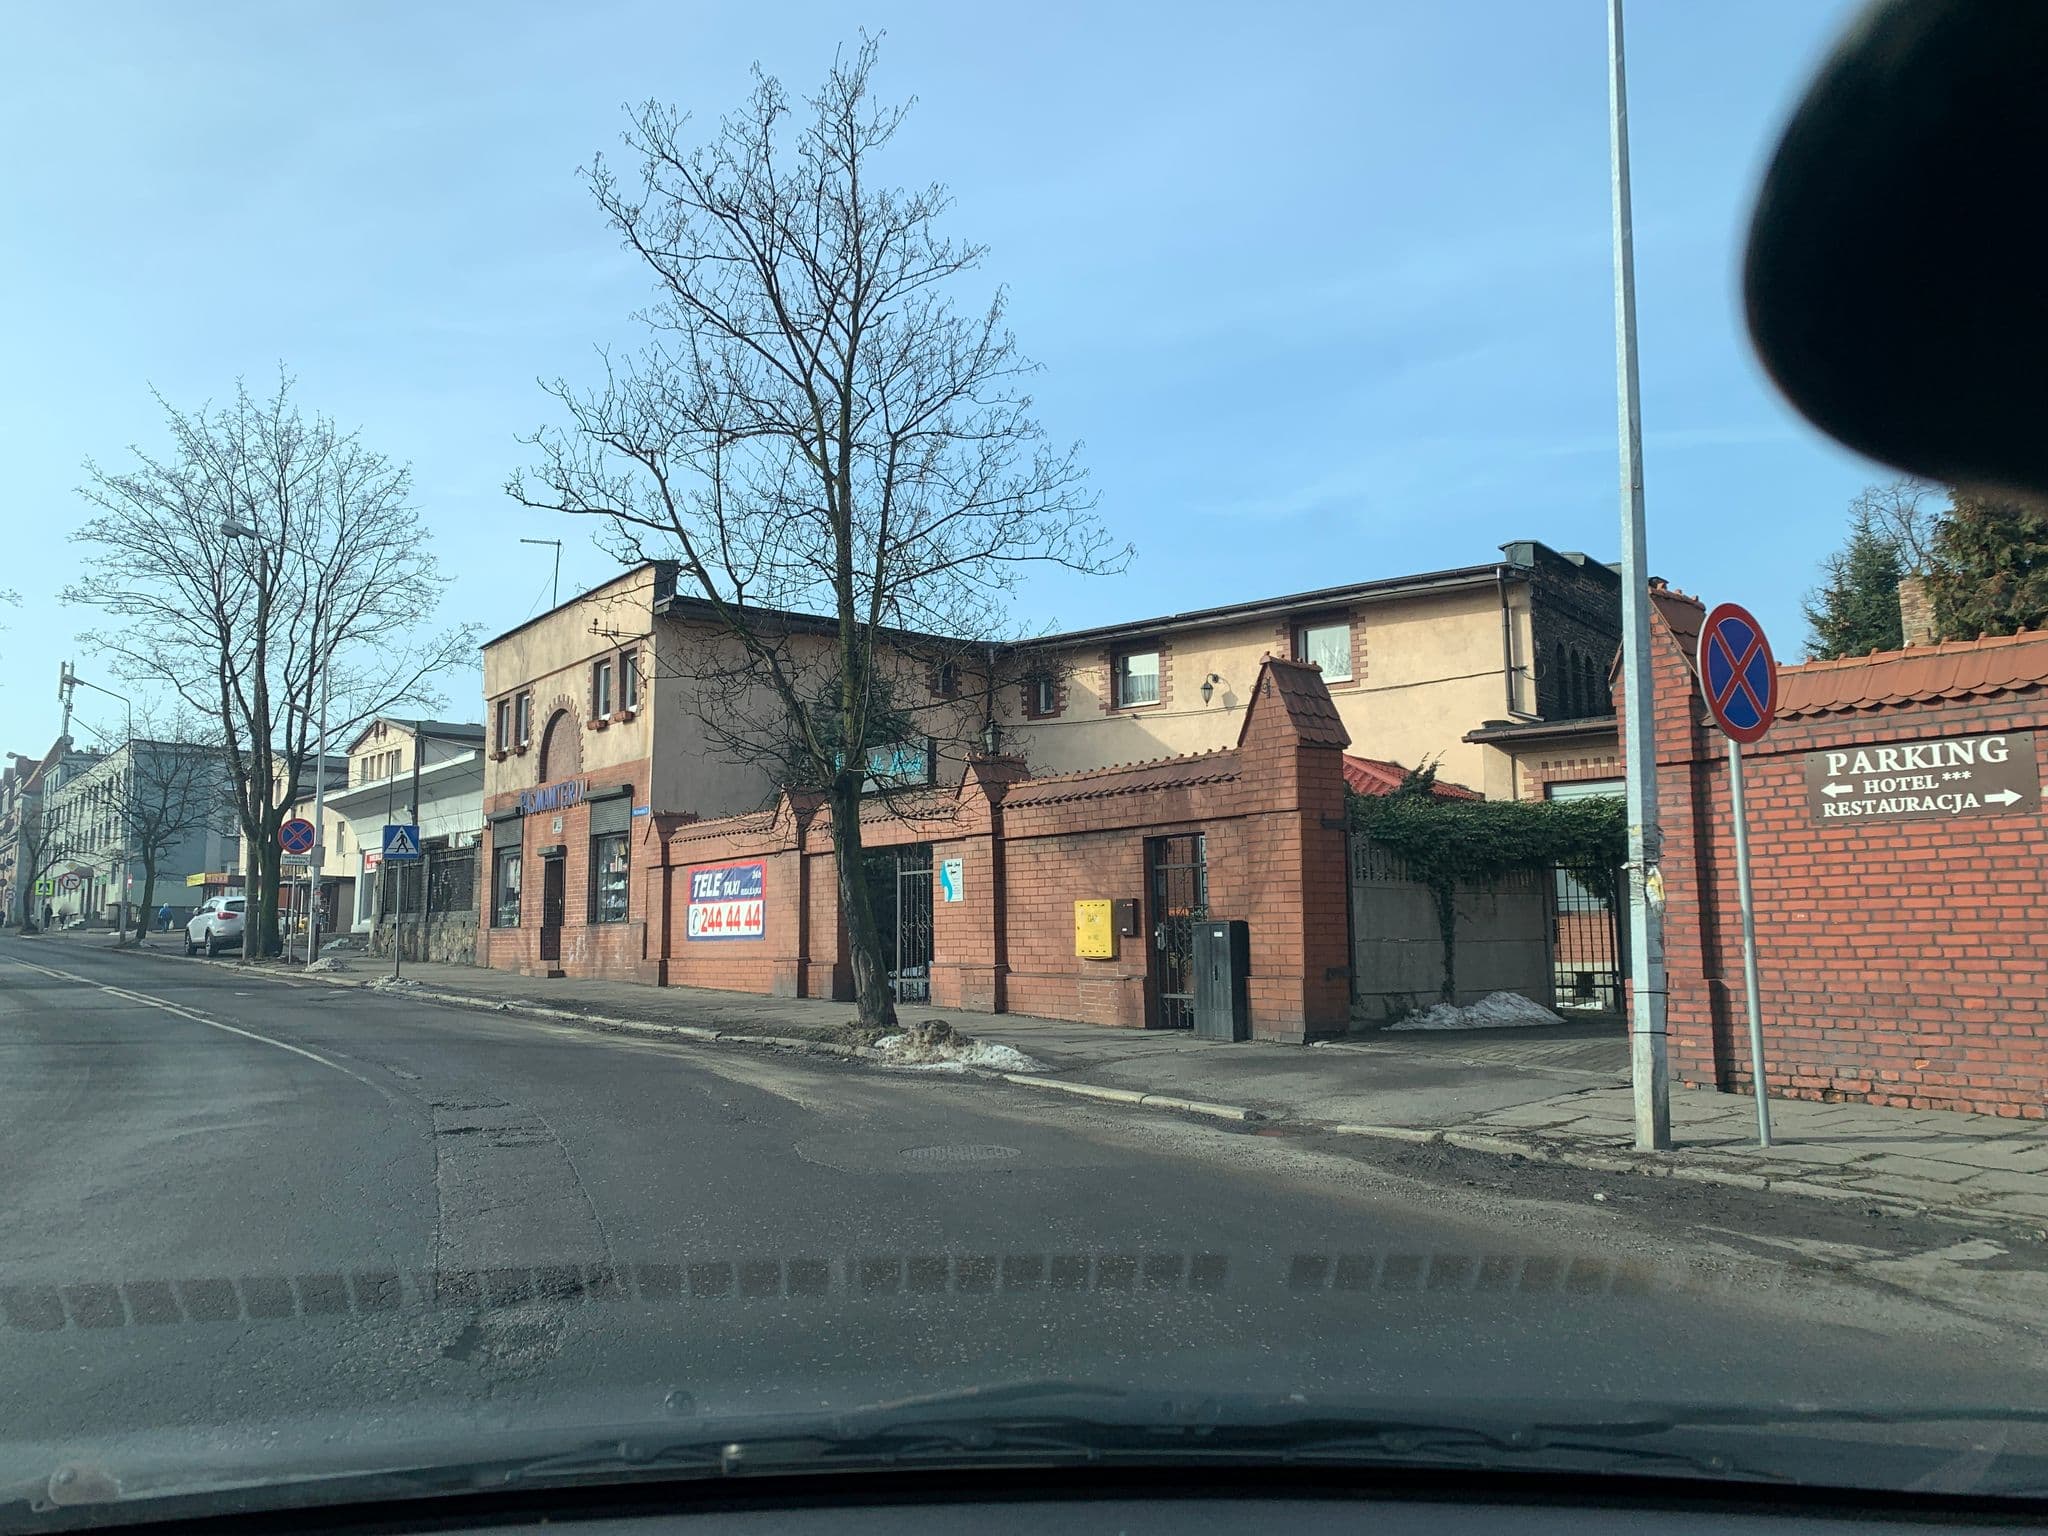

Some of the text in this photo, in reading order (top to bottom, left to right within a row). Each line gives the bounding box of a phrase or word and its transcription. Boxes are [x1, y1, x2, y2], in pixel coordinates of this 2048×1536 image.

[1825, 736, 2010, 777] PARKING
[1863, 774, 1940, 795] HOTEL
[1822, 792, 1981, 818] RESTAURACJA
[693, 872, 723, 898] TELE
[724, 880, 741, 896] TAXI
[701, 904, 761, 932] 244 44 44
